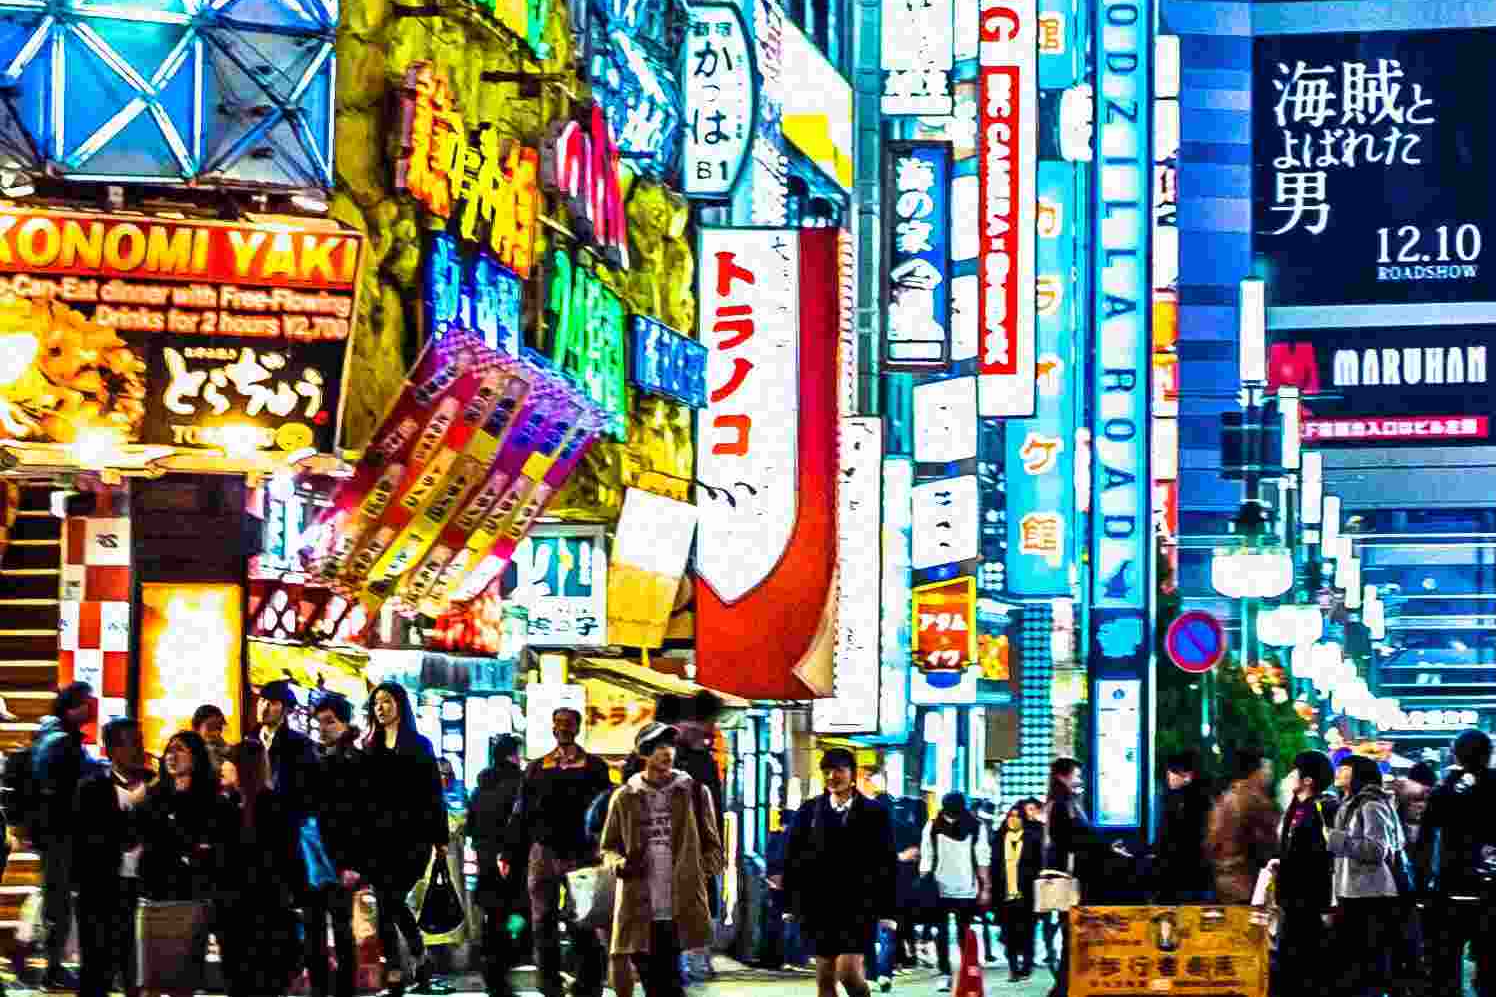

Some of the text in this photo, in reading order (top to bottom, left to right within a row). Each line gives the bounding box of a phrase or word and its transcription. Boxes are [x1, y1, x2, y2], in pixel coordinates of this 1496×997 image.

[1273, 59, 1436, 127] 海賊と
[697, 160, 730, 180] B1
[1272, 127, 1422, 170] よばれた
[1271, 170, 1331, 236] 男
[226, 229, 359, 284] YAKI
[1376, 223, 1482, 263] 12.10
[1376, 265, 1479, 282] ROADSHOW
[711, 252, 756, 457] トラノコ
[1333, 345, 1487, 386] MARUHAN
[1102, 367, 1137, 539] ROAD
